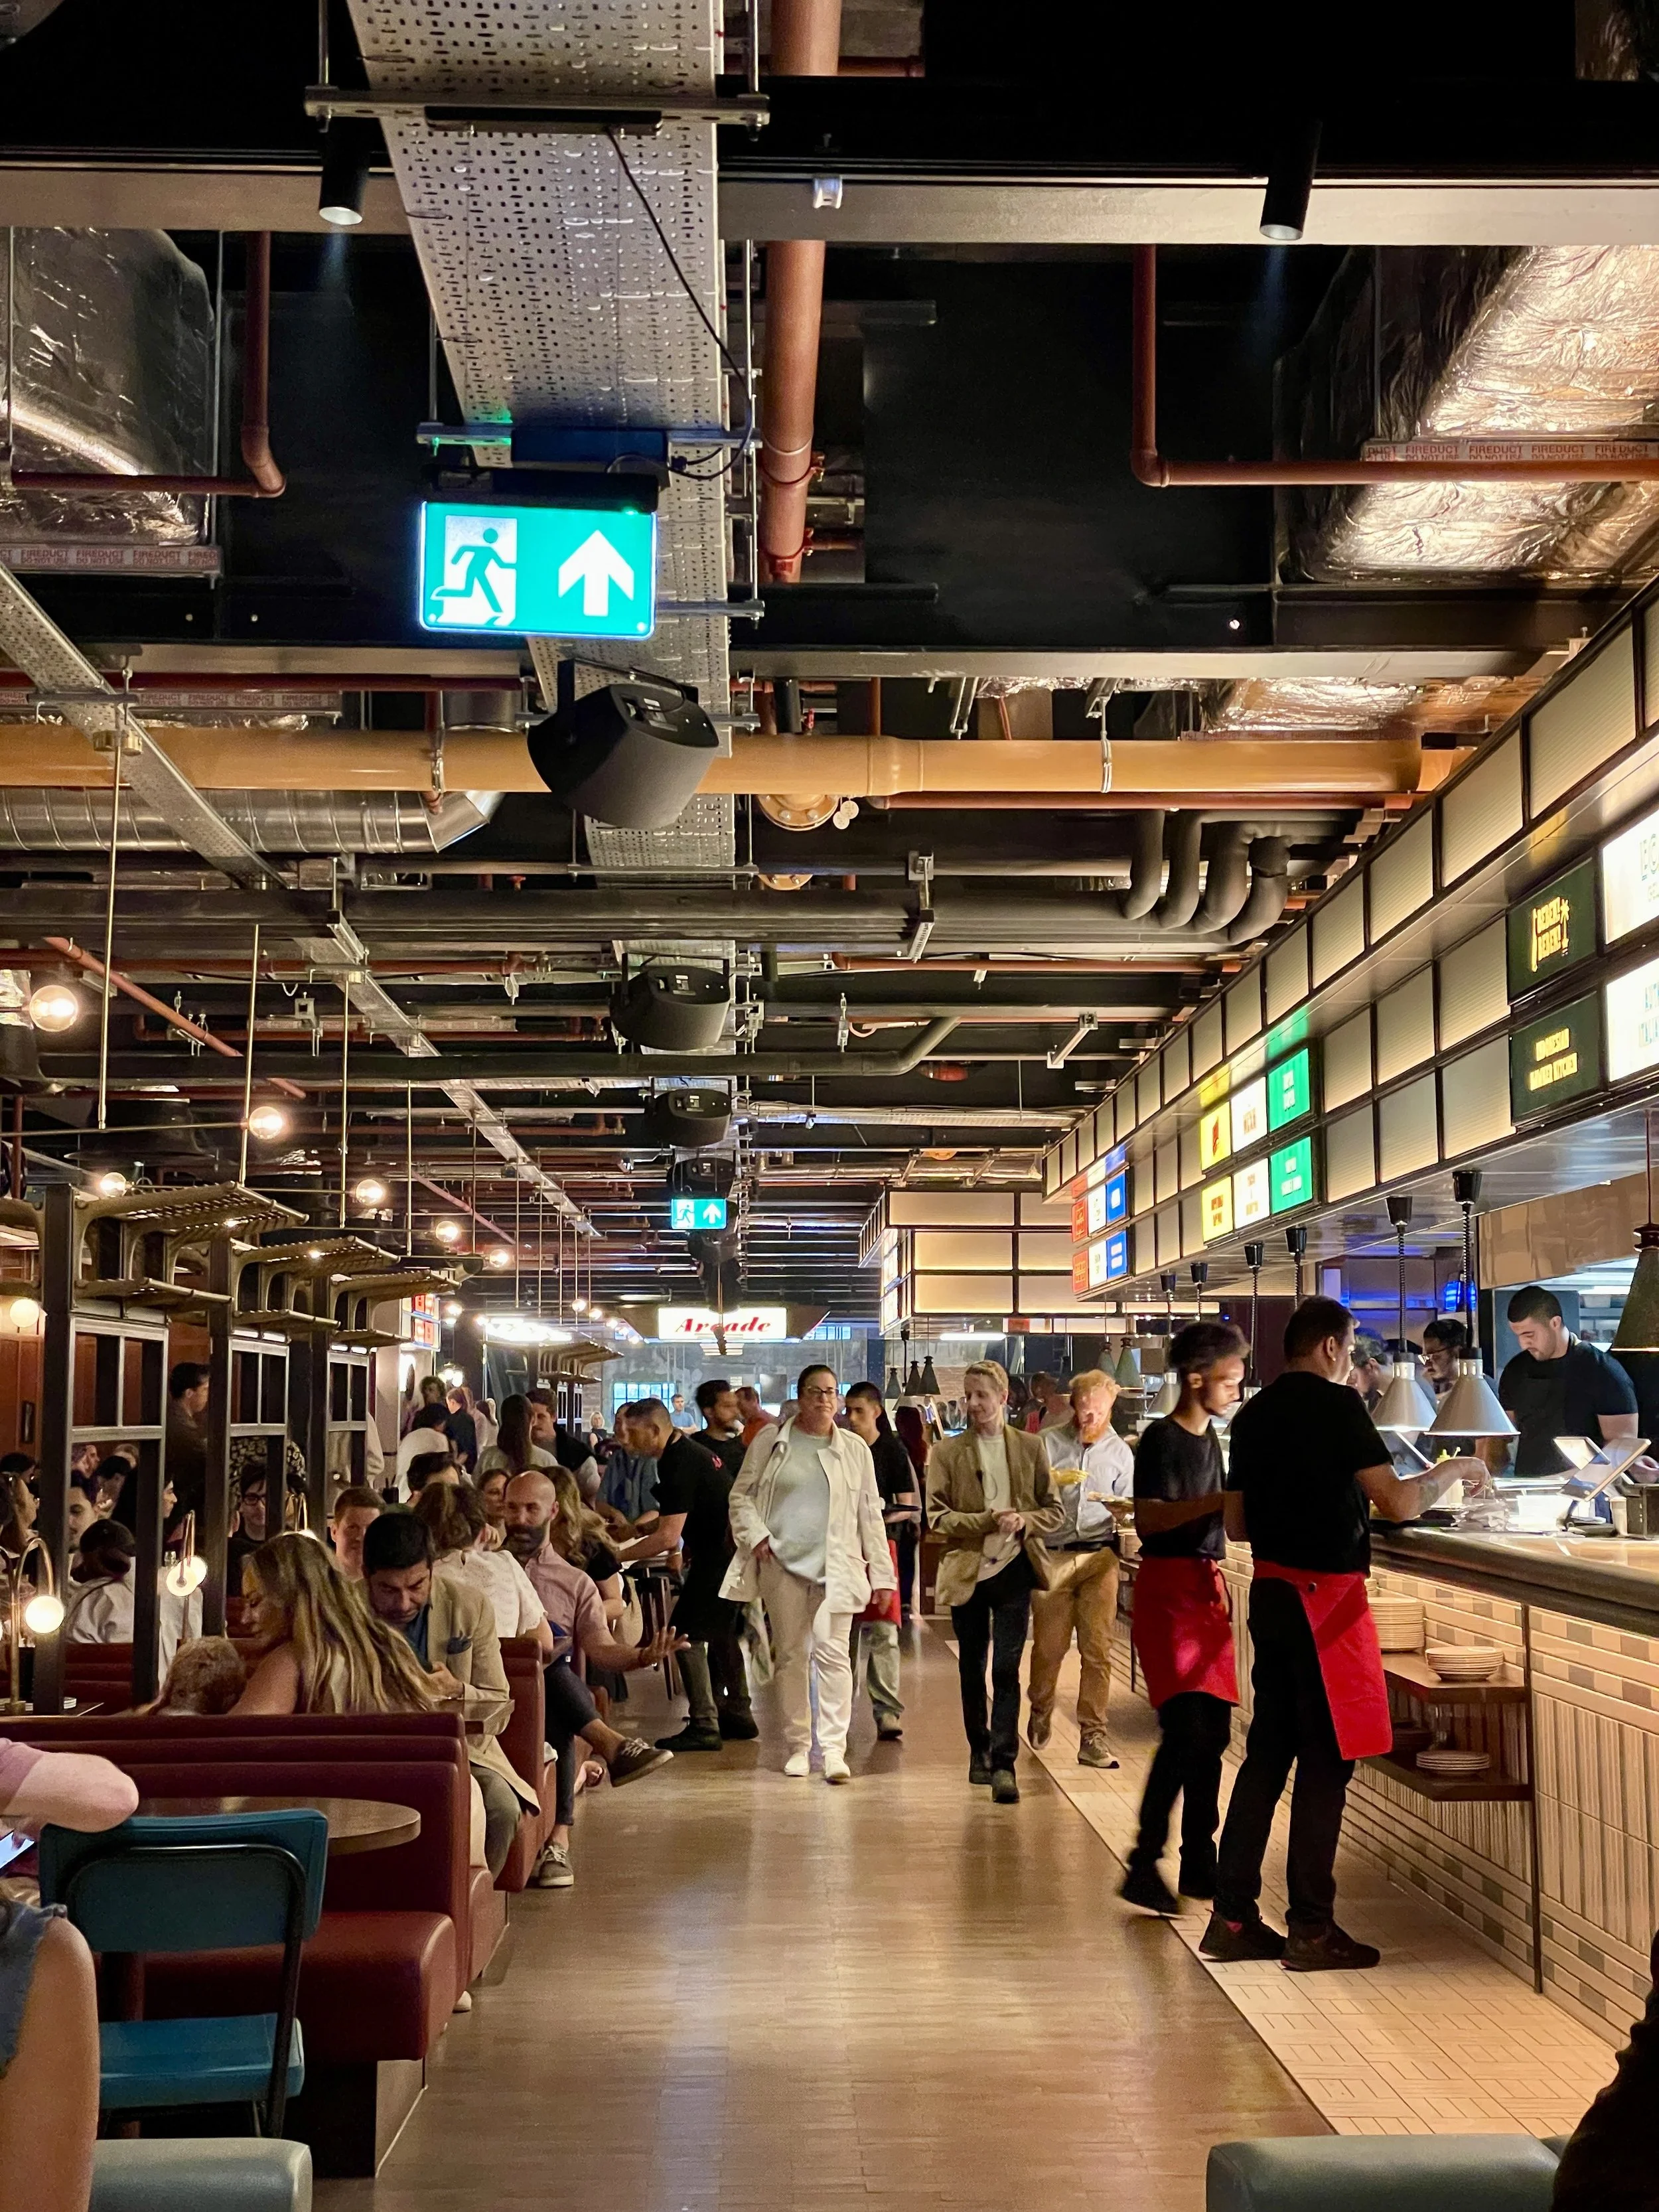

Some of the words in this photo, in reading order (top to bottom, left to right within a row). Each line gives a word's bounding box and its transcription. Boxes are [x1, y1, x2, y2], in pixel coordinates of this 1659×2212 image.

[1406, 445, 1459, 454] FIREDUCT
[1469, 445, 1522, 454] FIREDUCT
[1531, 445, 1585, 453] FIREDUCT
[1595, 445, 1648, 453] FIREDUCT
[676, 1317, 771, 1332] Arcade
